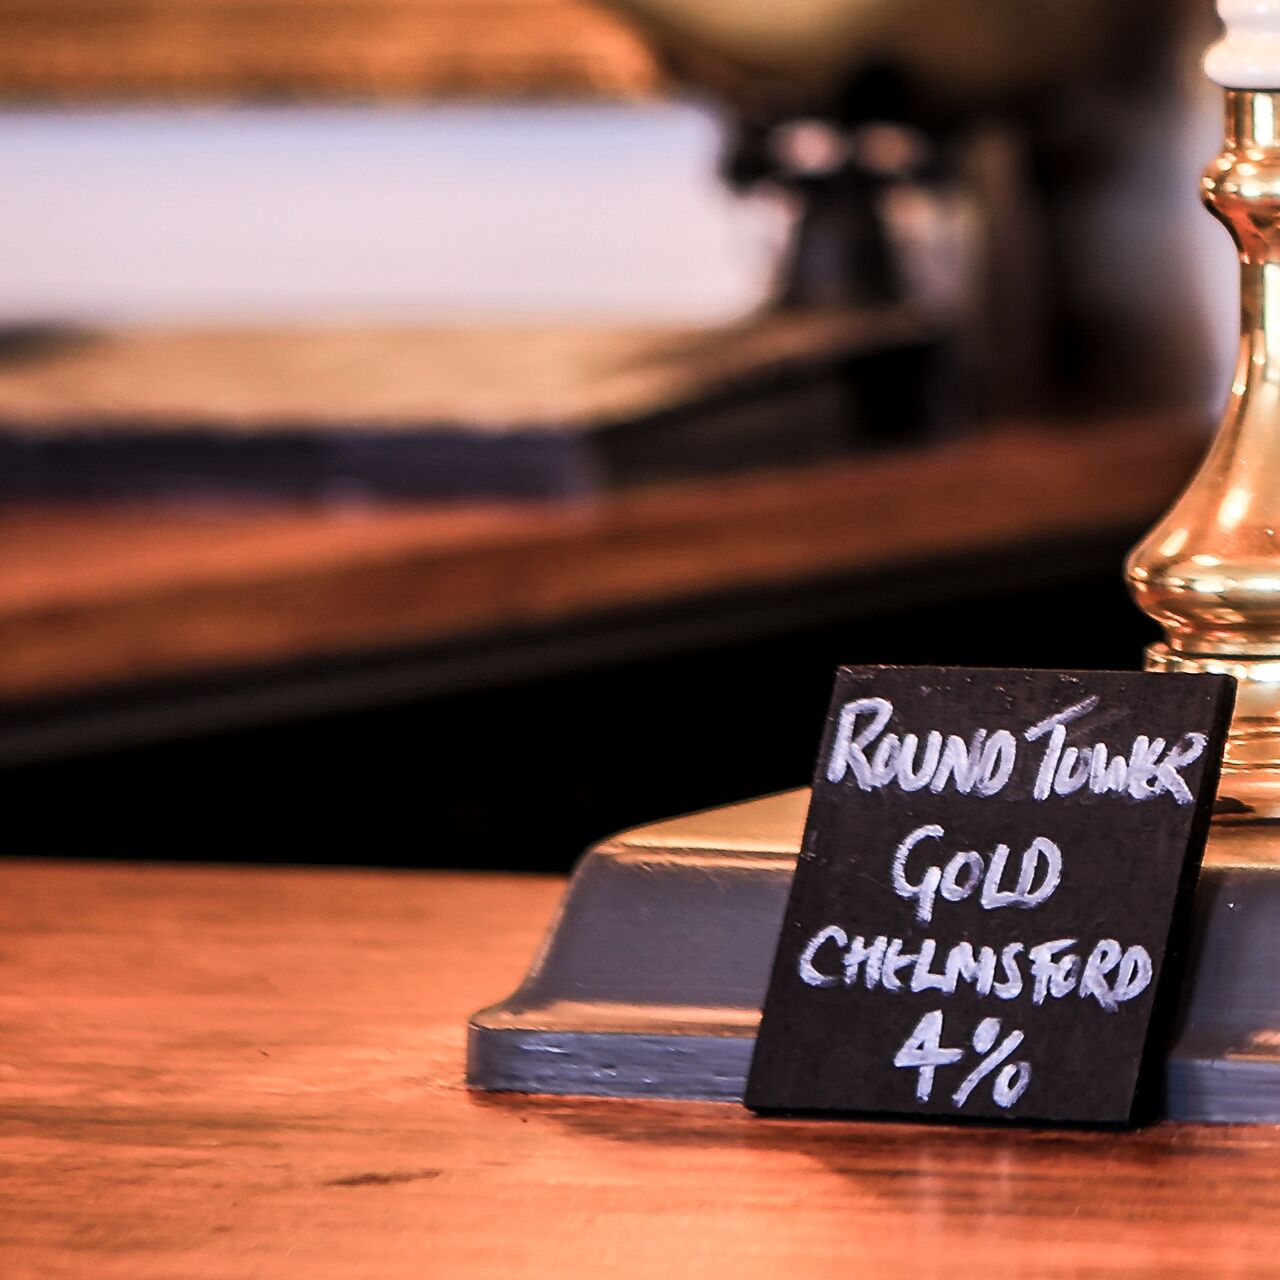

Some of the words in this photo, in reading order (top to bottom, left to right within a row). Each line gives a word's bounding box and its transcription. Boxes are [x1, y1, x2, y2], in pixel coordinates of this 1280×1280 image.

[828, 697, 1017, 797] ROUND
[892, 824, 1062, 923] GOLD
[799, 926, 1153, 1012] CHELMSFORD
[894, 1010, 1031, 1108] 4%
